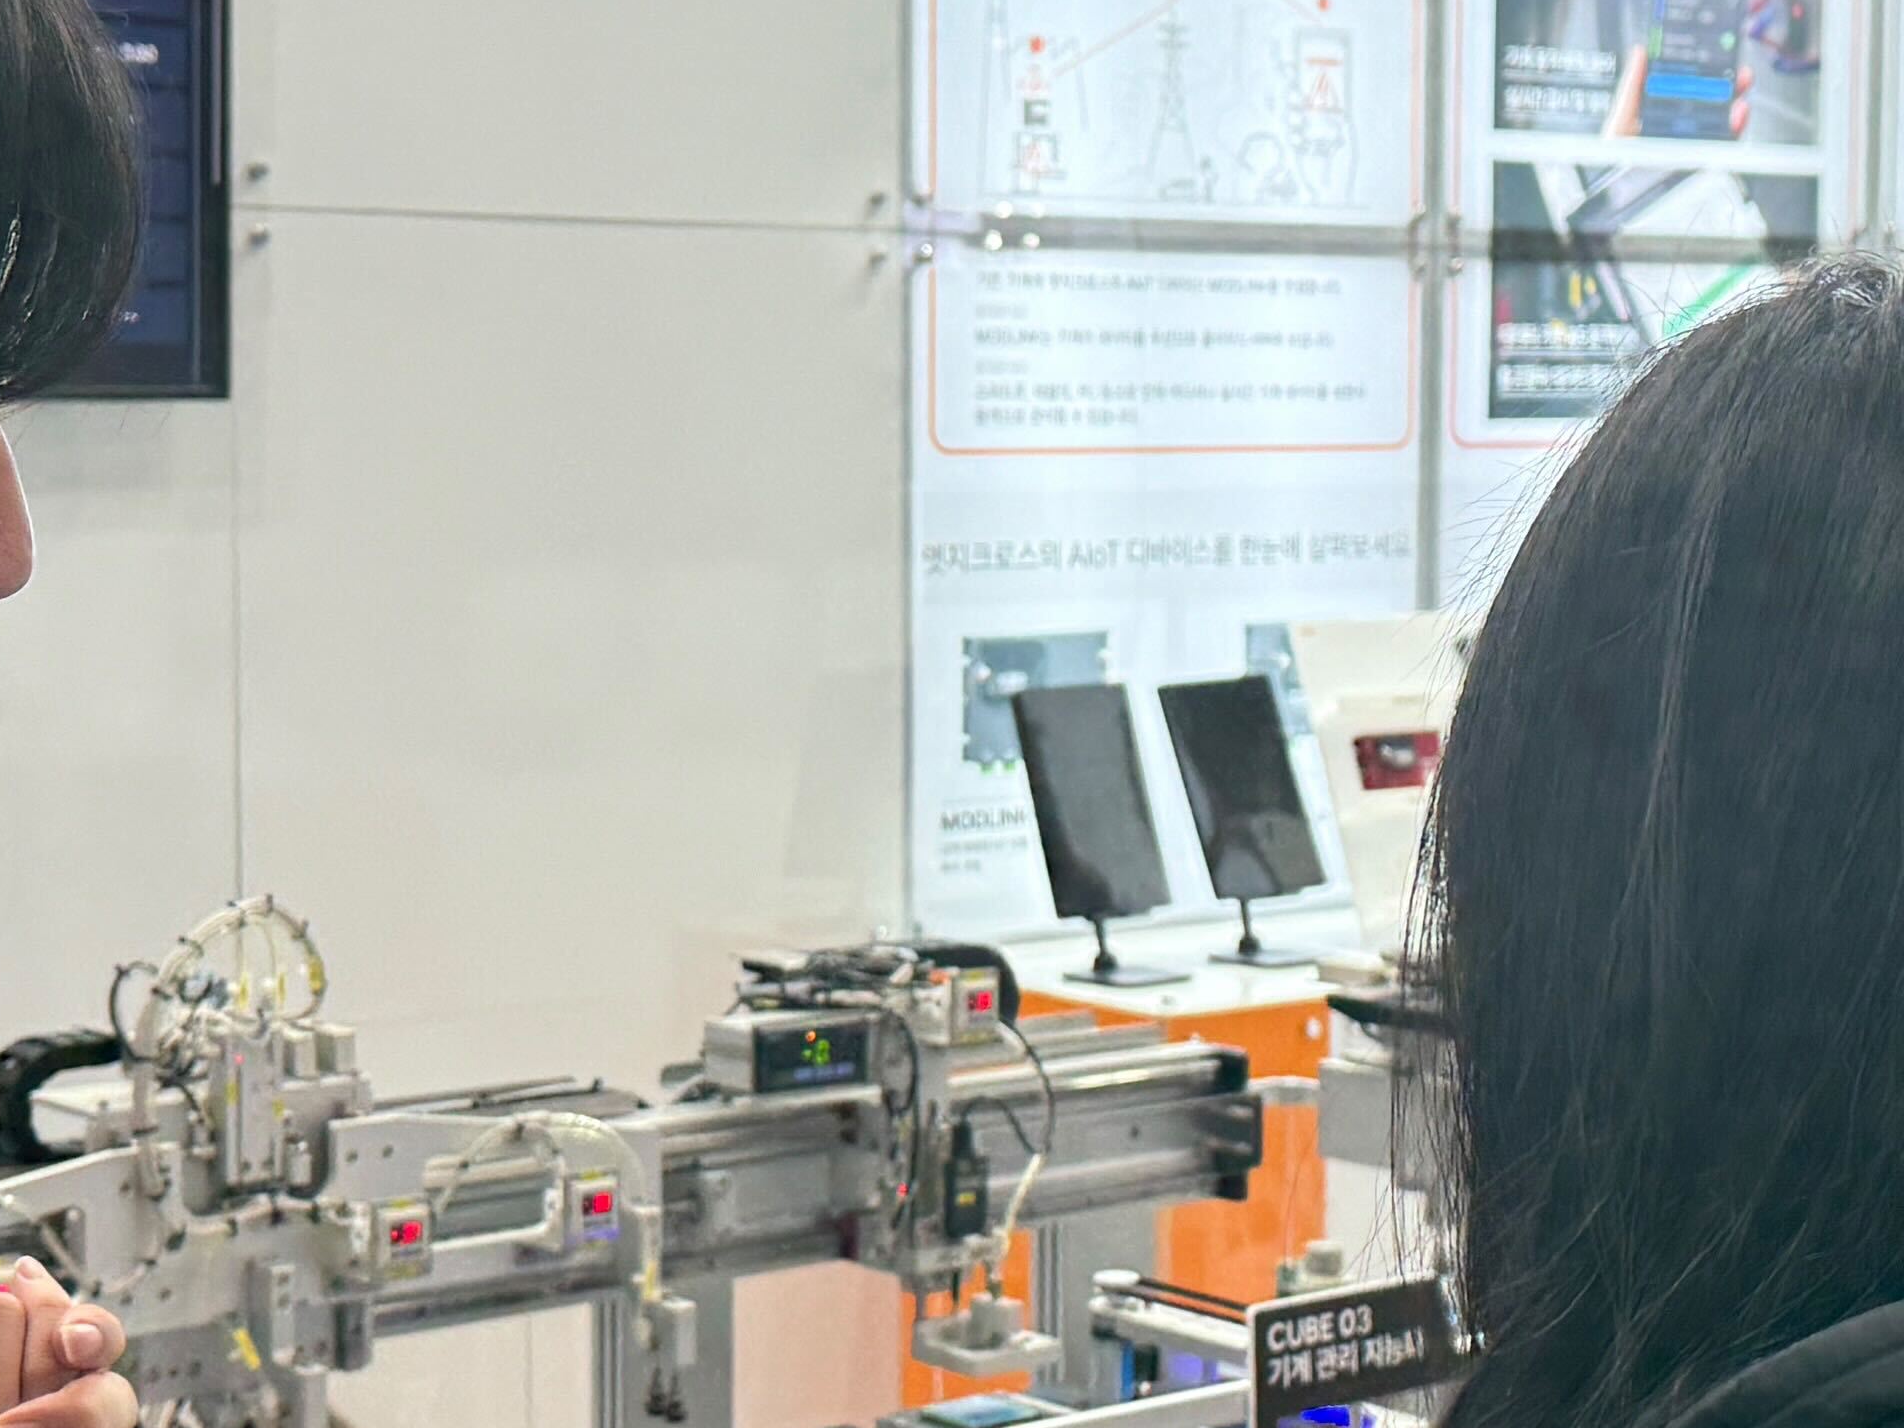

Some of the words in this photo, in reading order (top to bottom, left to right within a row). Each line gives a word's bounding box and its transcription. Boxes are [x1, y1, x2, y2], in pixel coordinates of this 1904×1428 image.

[1066, 536, 1118, 570] AIoT
[1125, 534, 1235, 568] 디바이스를
[1265, 1309, 1336, 1354] CUBE
[1337, 1304, 1375, 1339] 03
[1265, 1349, 1314, 1390] 기계
[1315, 1338, 1360, 1382] 관리
